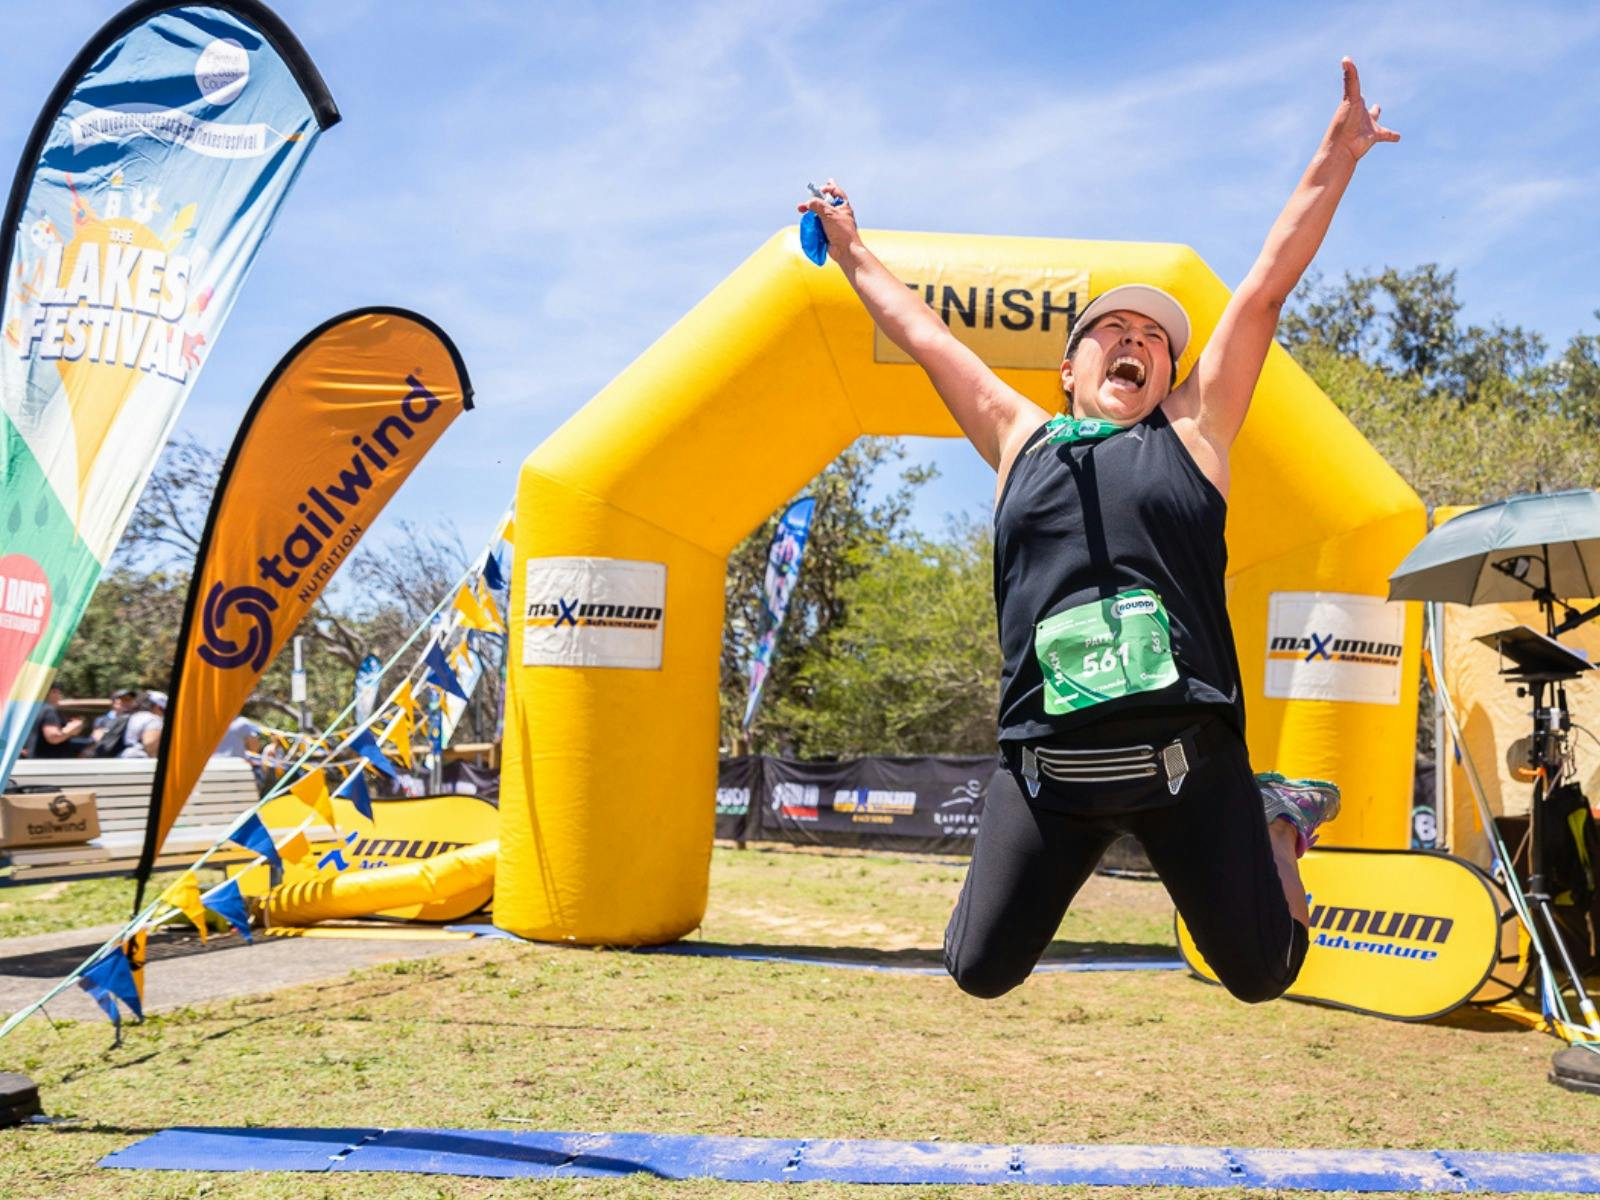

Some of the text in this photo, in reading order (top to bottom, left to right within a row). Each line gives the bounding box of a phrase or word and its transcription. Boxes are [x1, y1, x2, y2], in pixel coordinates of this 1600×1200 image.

[109, 228, 134, 244] THE
[40, 241, 192, 324] LAKES
[905, 283, 1077, 332] INISH
[20, 306, 188, 385] FESTIVAL
[257, 374, 443, 589] tailwind
[298, 523, 362, 603] NUTRITION
[6, 577, 48, 619] DAYS
[583, 617, 658, 631] Adventure
[1082, 641, 1130, 679] 561
[1337, 653, 1399, 667] Adventure
[26, 818, 88, 835] tailwind
[1314, 932, 1438, 962] Adventure
